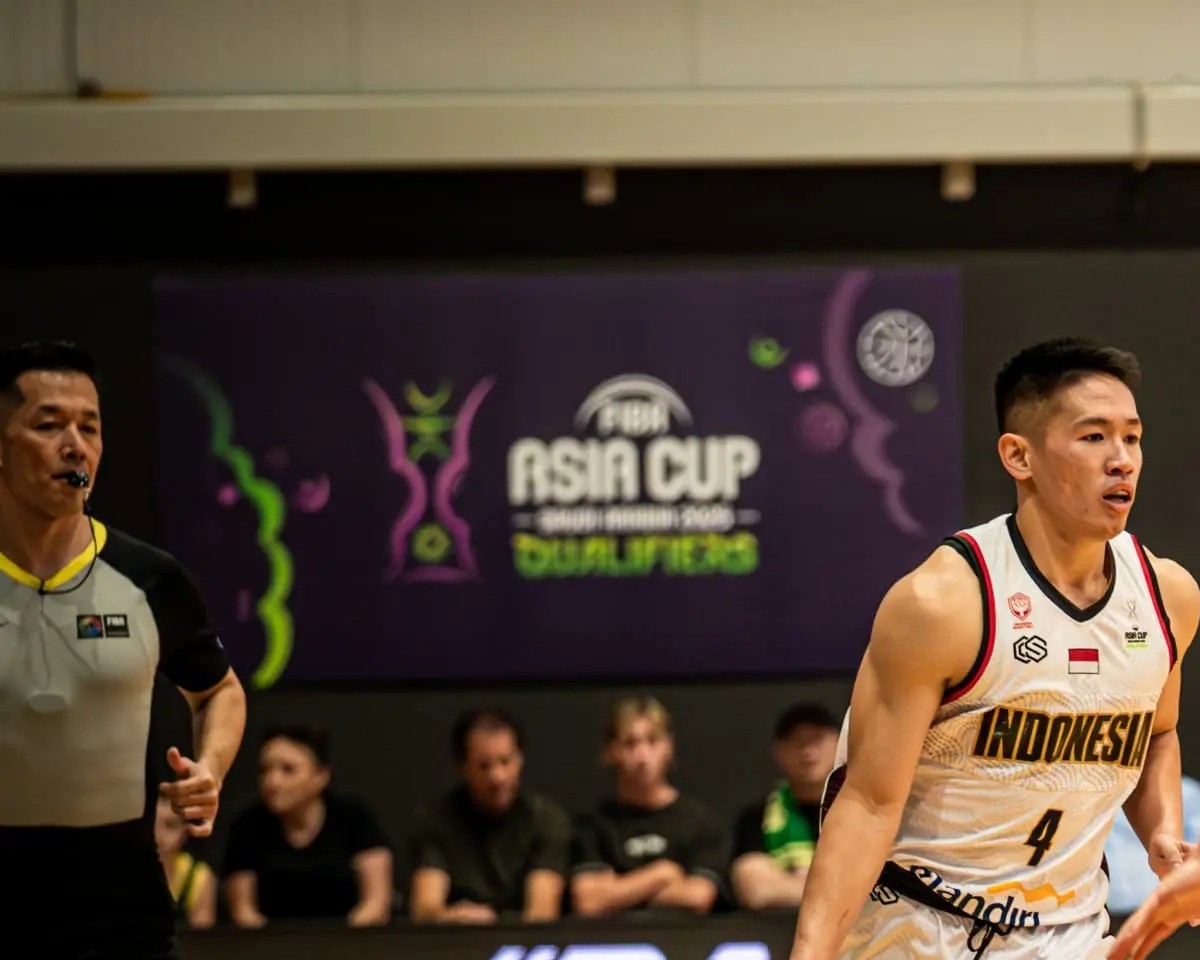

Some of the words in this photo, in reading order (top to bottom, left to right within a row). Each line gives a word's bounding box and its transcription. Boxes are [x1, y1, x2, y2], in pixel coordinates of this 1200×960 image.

[508, 437, 640, 505] ASIA
[645, 434, 761, 502] CUP
[1024, 808, 1064, 867] 4
